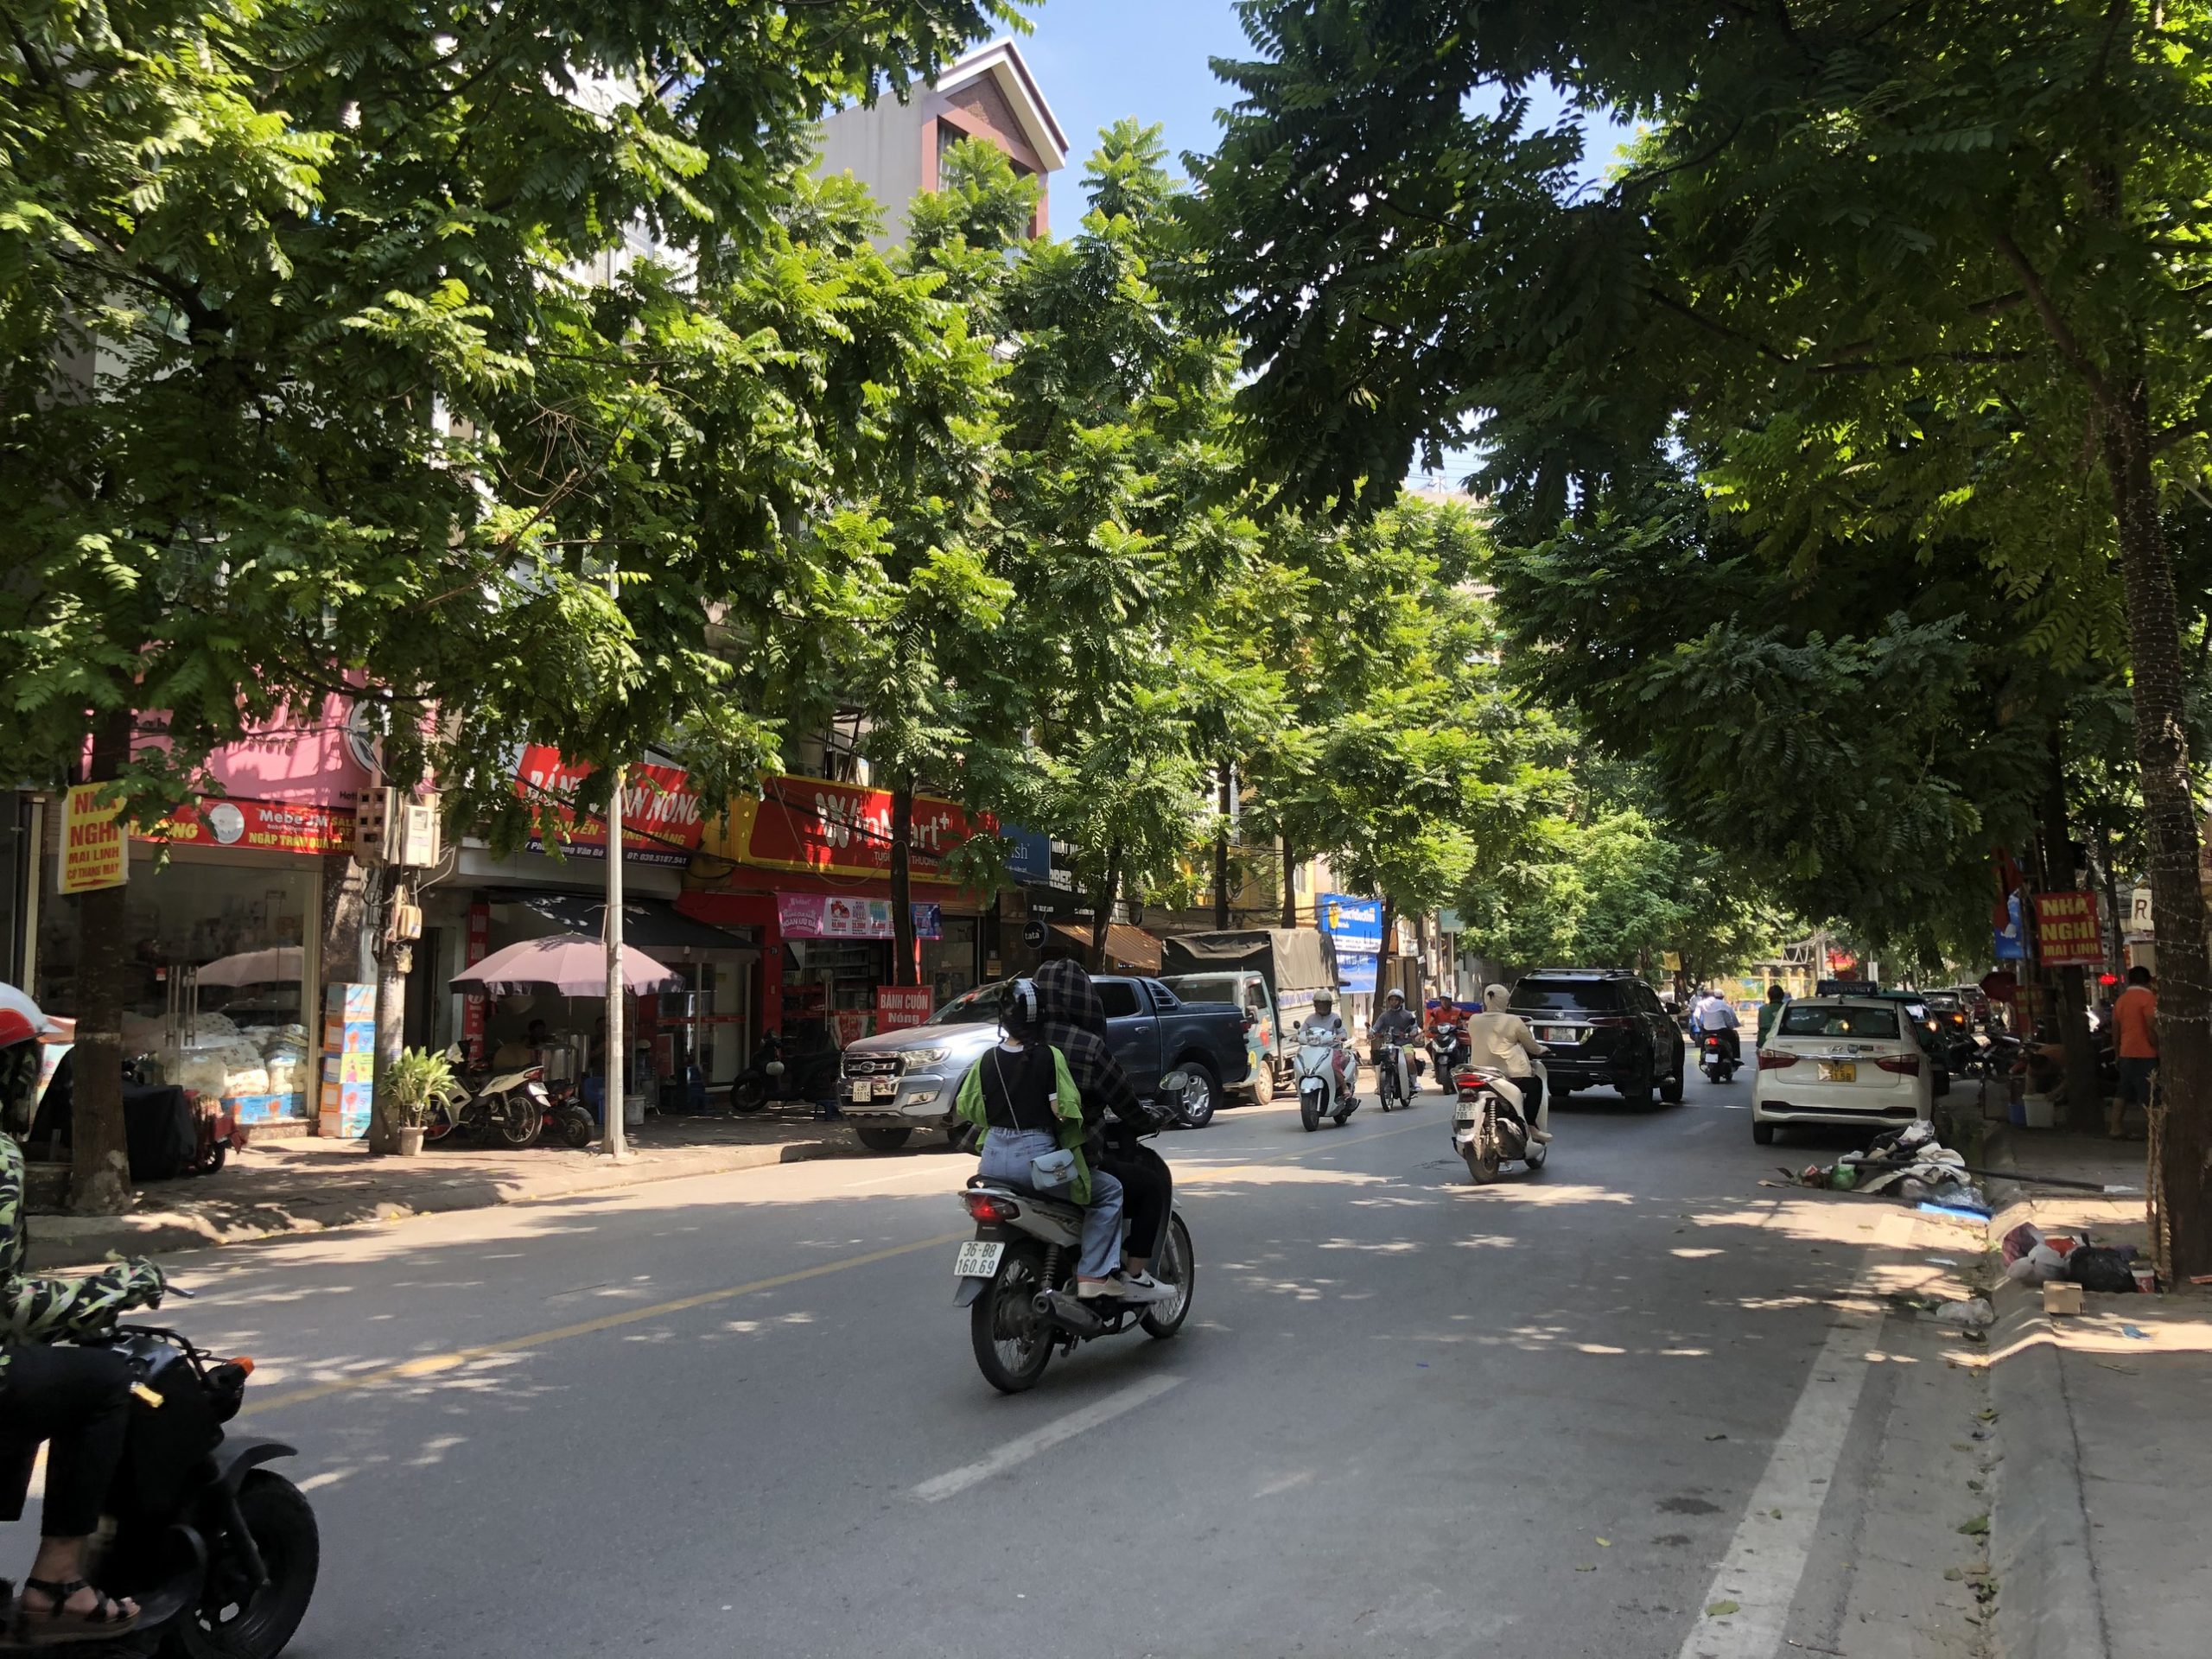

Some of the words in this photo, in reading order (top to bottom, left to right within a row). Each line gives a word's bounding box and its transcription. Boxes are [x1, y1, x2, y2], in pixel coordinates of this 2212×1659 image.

[68, 849, 91, 865] MAI
[93, 846, 119, 861] LINH
[2041, 893, 2089, 918] NHÀ
[2040, 915, 2096, 941] NGHỈ
[2044, 945, 2068, 957] MAI
[2071, 943, 2099, 955] LINH
[880, 989, 904, 1009] BÁNH
[905, 989, 929, 1009] CUỐN
[887, 1012, 920, 1026] Nóng
[963, 1243, 997, 1258] 36-B8
[957, 1258, 995, 1274] 160.69
